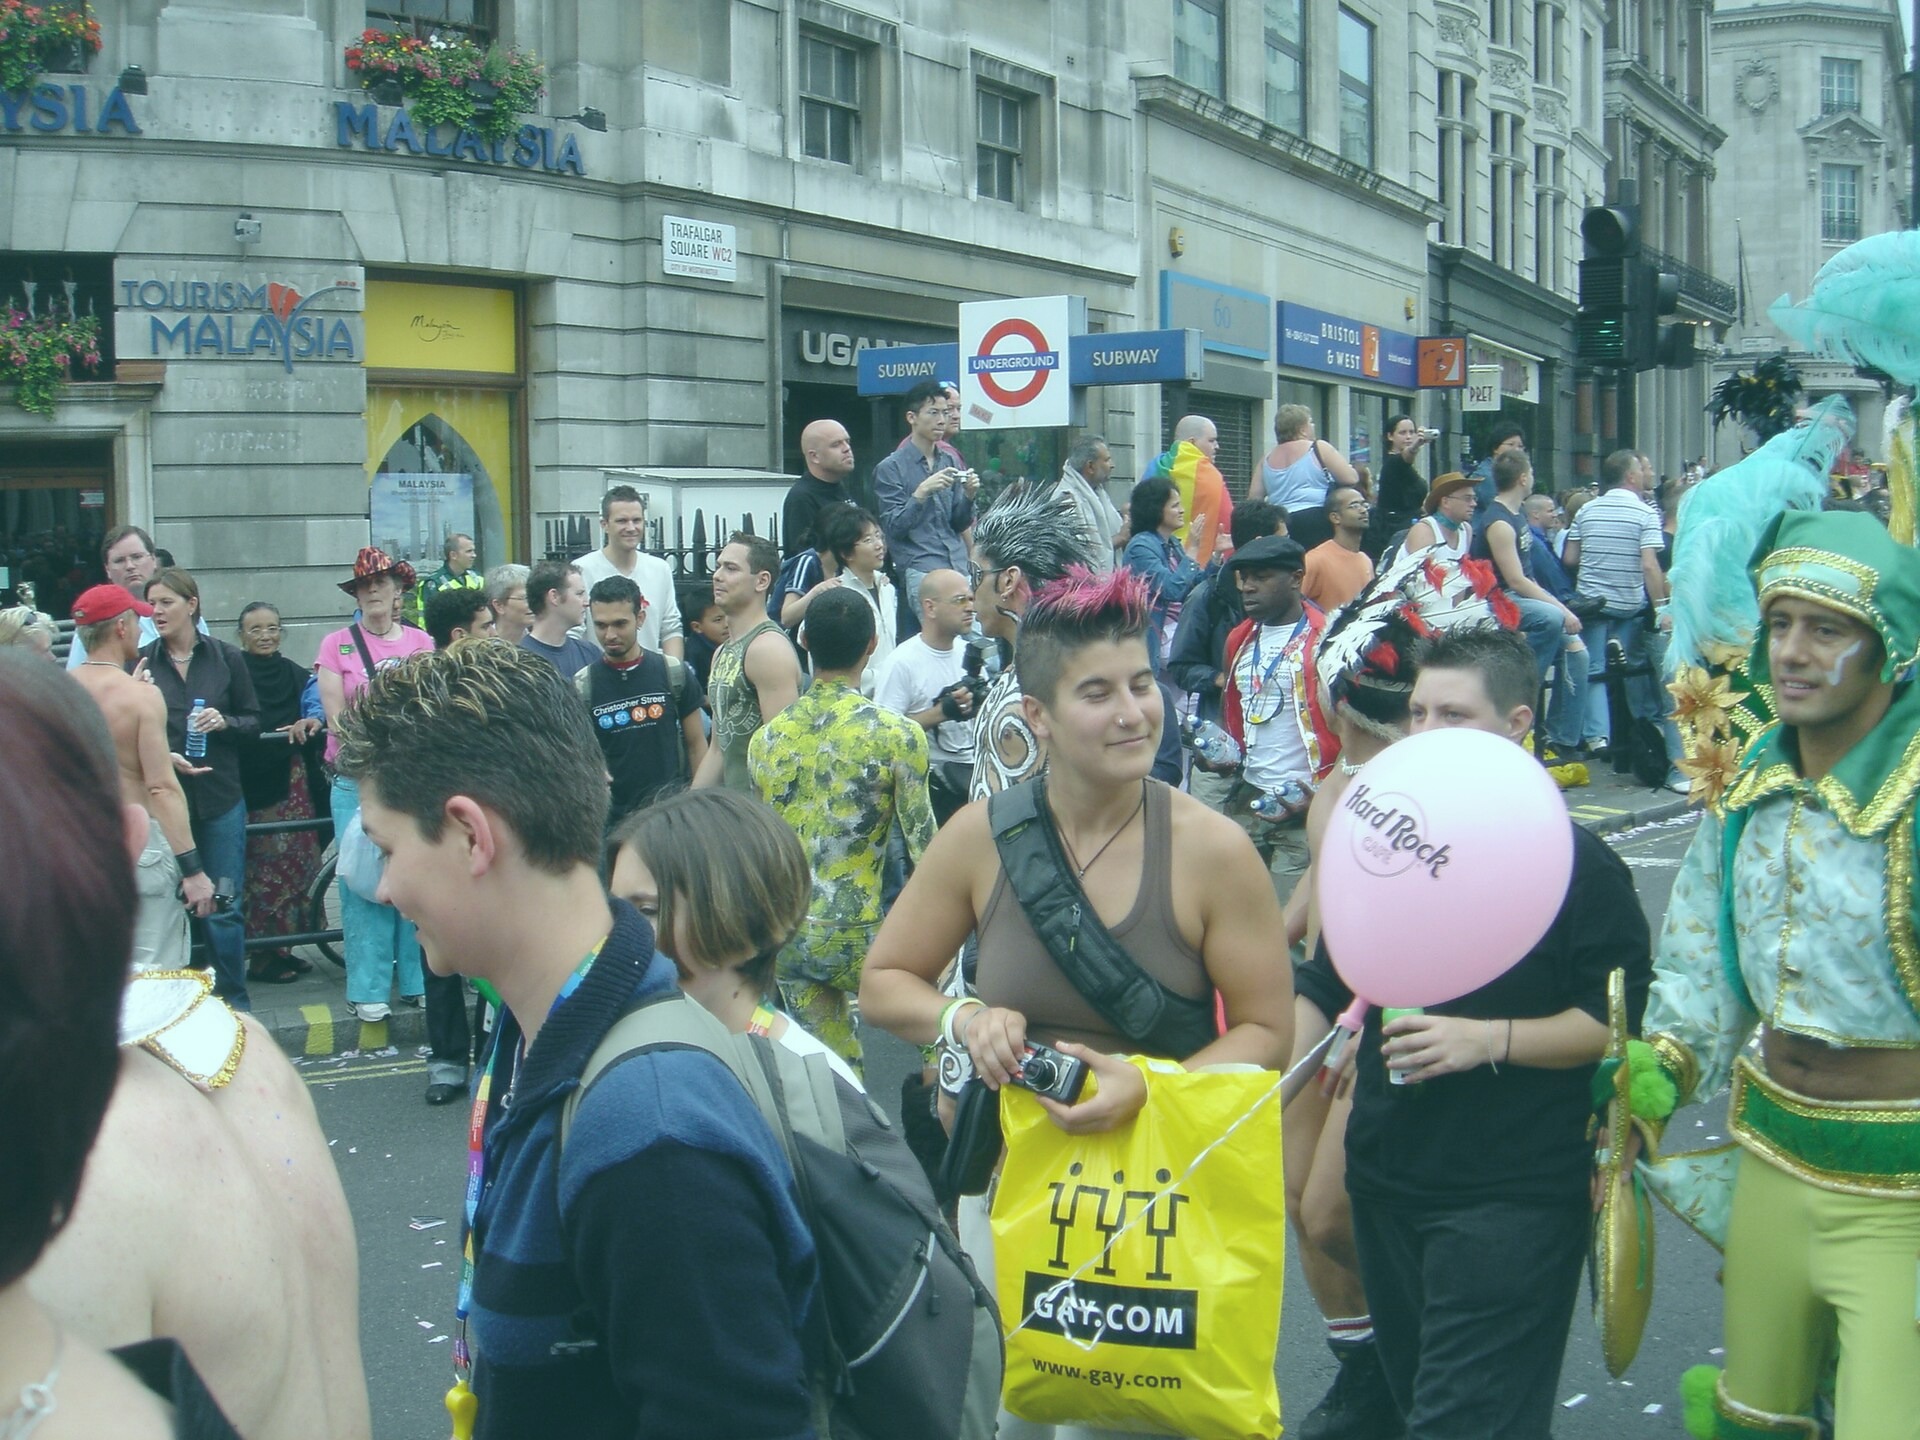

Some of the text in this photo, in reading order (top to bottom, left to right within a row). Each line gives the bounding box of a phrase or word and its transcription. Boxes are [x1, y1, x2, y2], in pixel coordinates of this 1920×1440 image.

[670, 222, 722, 243] TRAFALGAR
[670, 240, 732, 262] SQUARE WC2
[121, 280, 268, 312] TOURISM
[1214, 297, 1231, 329] 60
[150, 313, 354, 374] MALAYSIA
[1321, 322, 1361, 346] BRISTOL
[802, 329, 918, 367] UGA
[1093, 348, 1160, 367] SUBWAY
[878, 361, 937, 378] SUBWAY
[973, 355, 1054, 370] UNDERGROUND
[1327, 349, 1361, 370] & WEST
[1469, 385, 1493, 403] PRET
[398, 480, 446, 489] MALAYSIA
[593, 695, 666, 717] Christopher Street
[1345, 784, 1451, 879] Hard Rock
[1034, 1291, 1183, 1335] GAY.COM
[1032, 1358, 1182, 1389] www.gay.com
